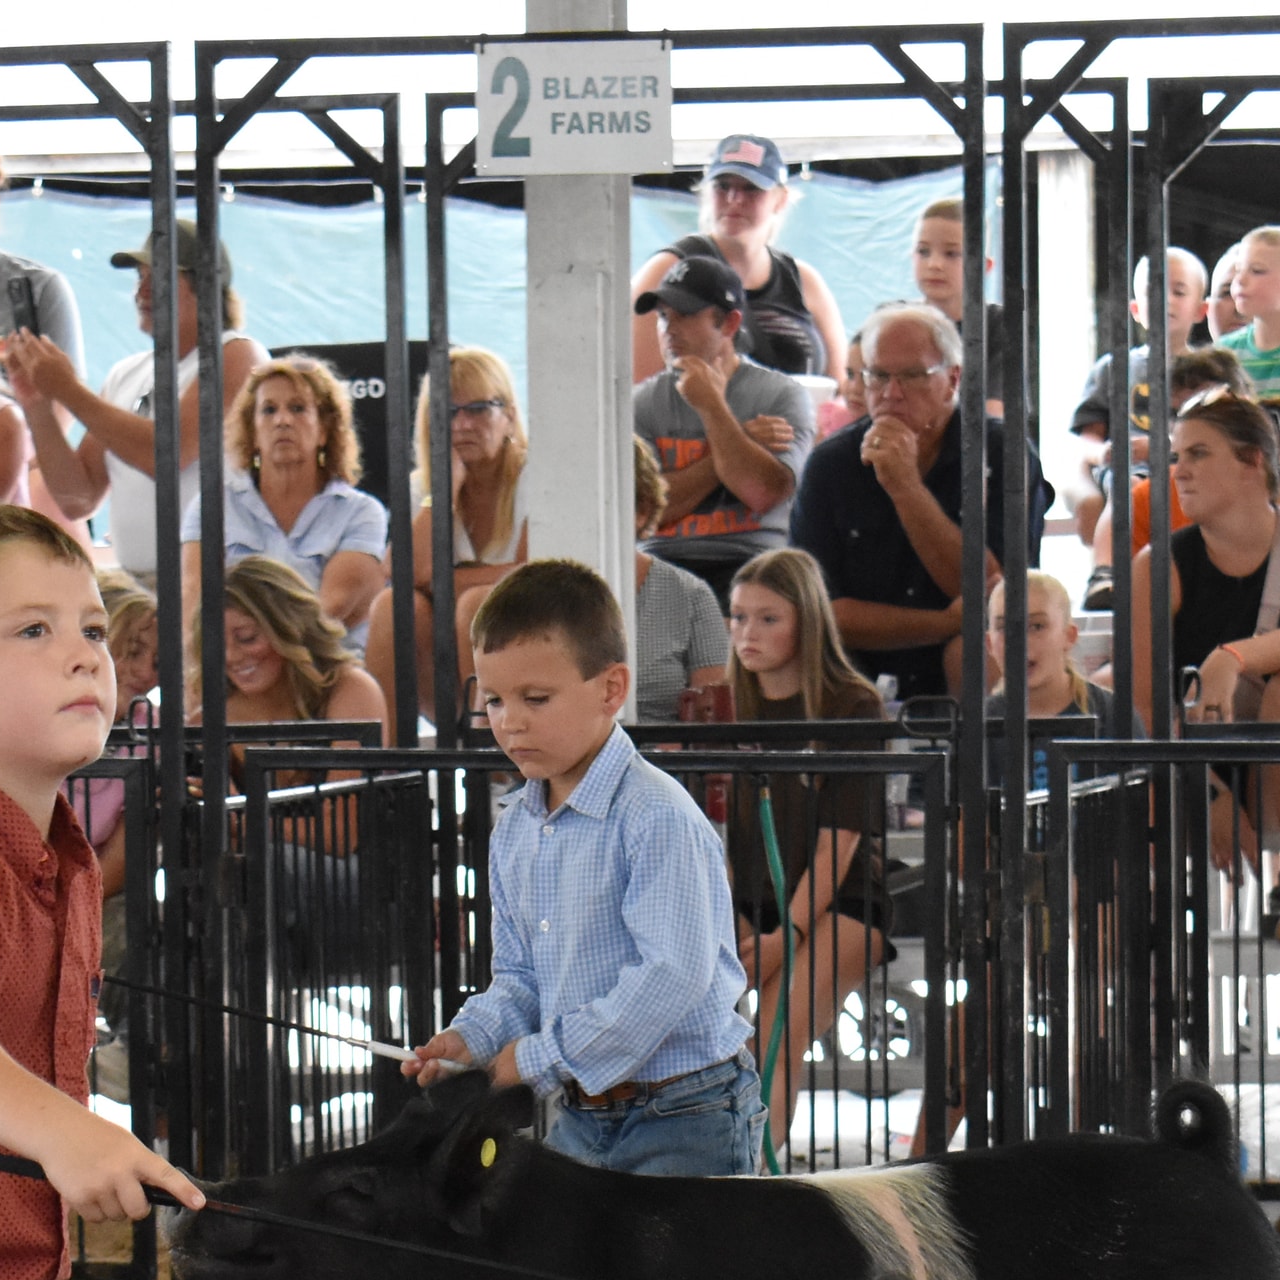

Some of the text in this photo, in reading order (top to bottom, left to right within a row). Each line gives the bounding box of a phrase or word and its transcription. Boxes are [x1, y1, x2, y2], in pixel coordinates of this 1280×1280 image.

[542, 75, 659, 100] BLAZER
[491, 56, 531, 158] 2
[550, 110, 652, 135] FARMS
